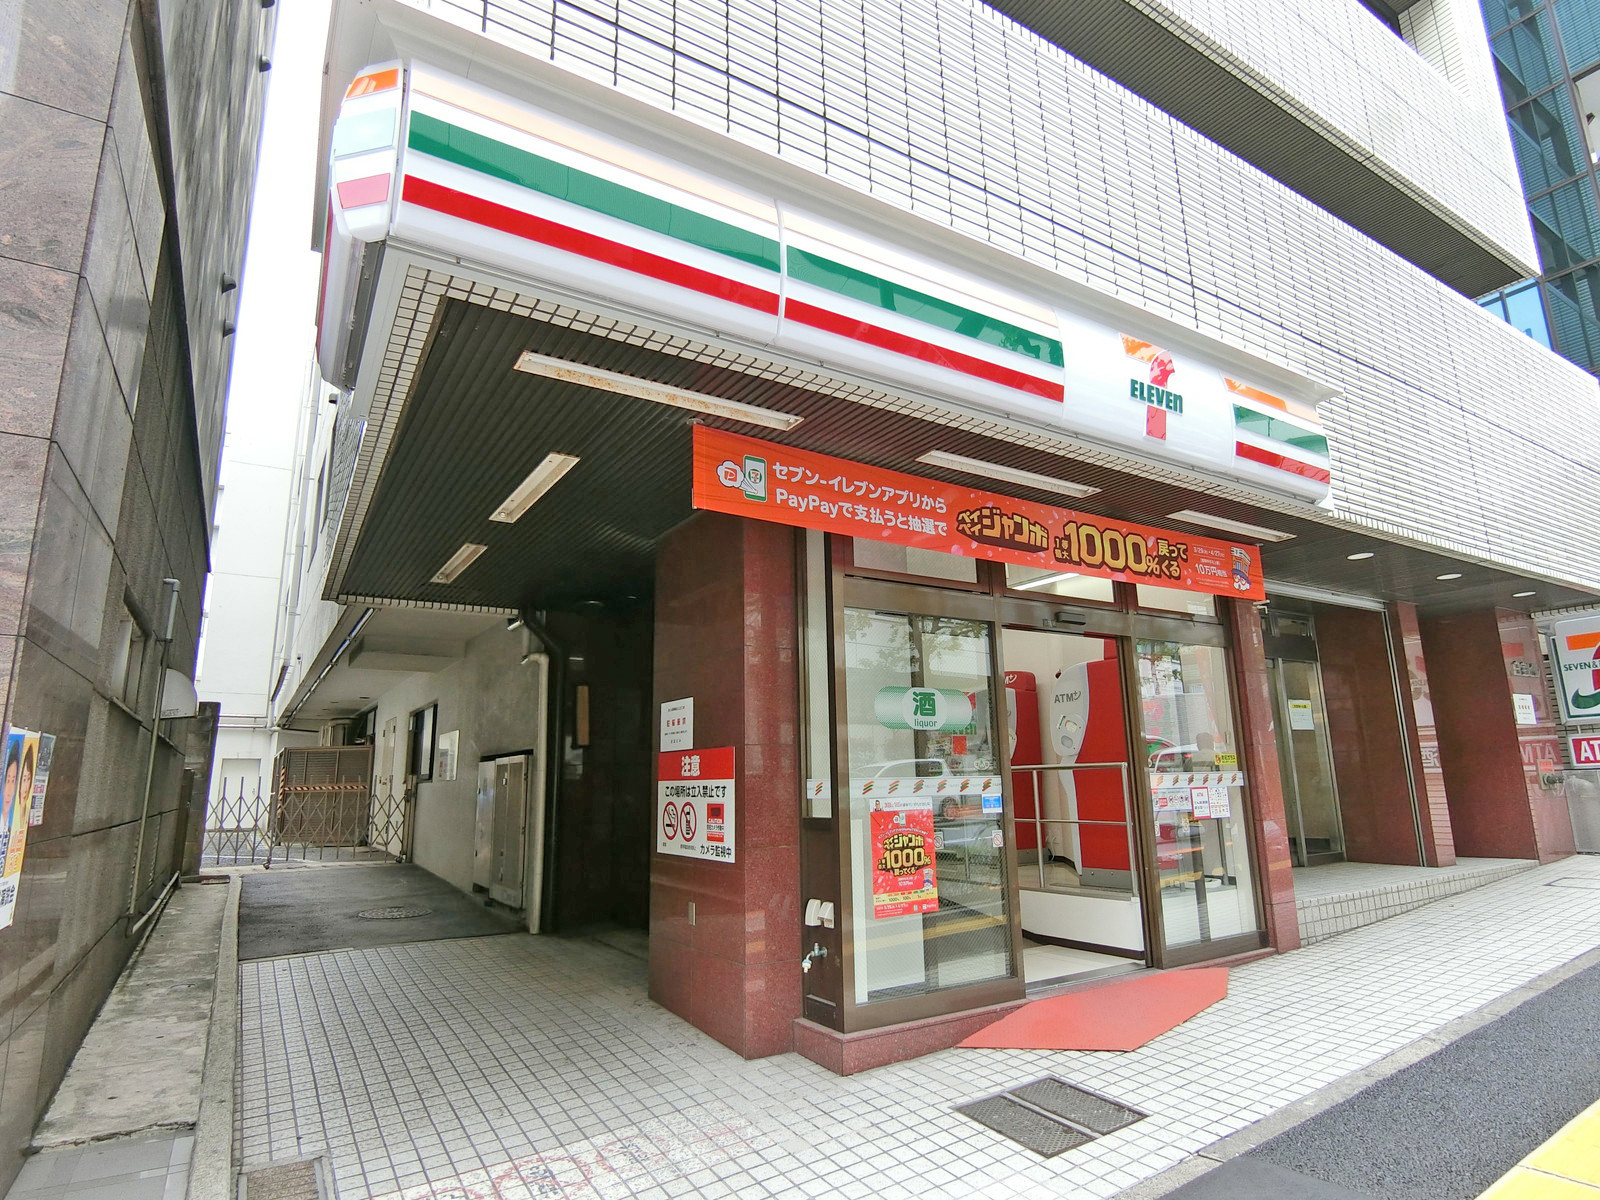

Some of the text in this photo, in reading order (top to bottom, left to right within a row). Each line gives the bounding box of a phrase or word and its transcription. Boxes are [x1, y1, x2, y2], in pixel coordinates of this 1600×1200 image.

[776, 488, 948, 536] PayPayで支払うと抽選で
[913, 691, 937, 716] 酒
[914, 719, 938, 728] liquor
[681, 755, 700, 777] 注意
[665, 785, 727, 798] この場所は立入禁止です
[700, 844, 731, 858] カメラ監視中
